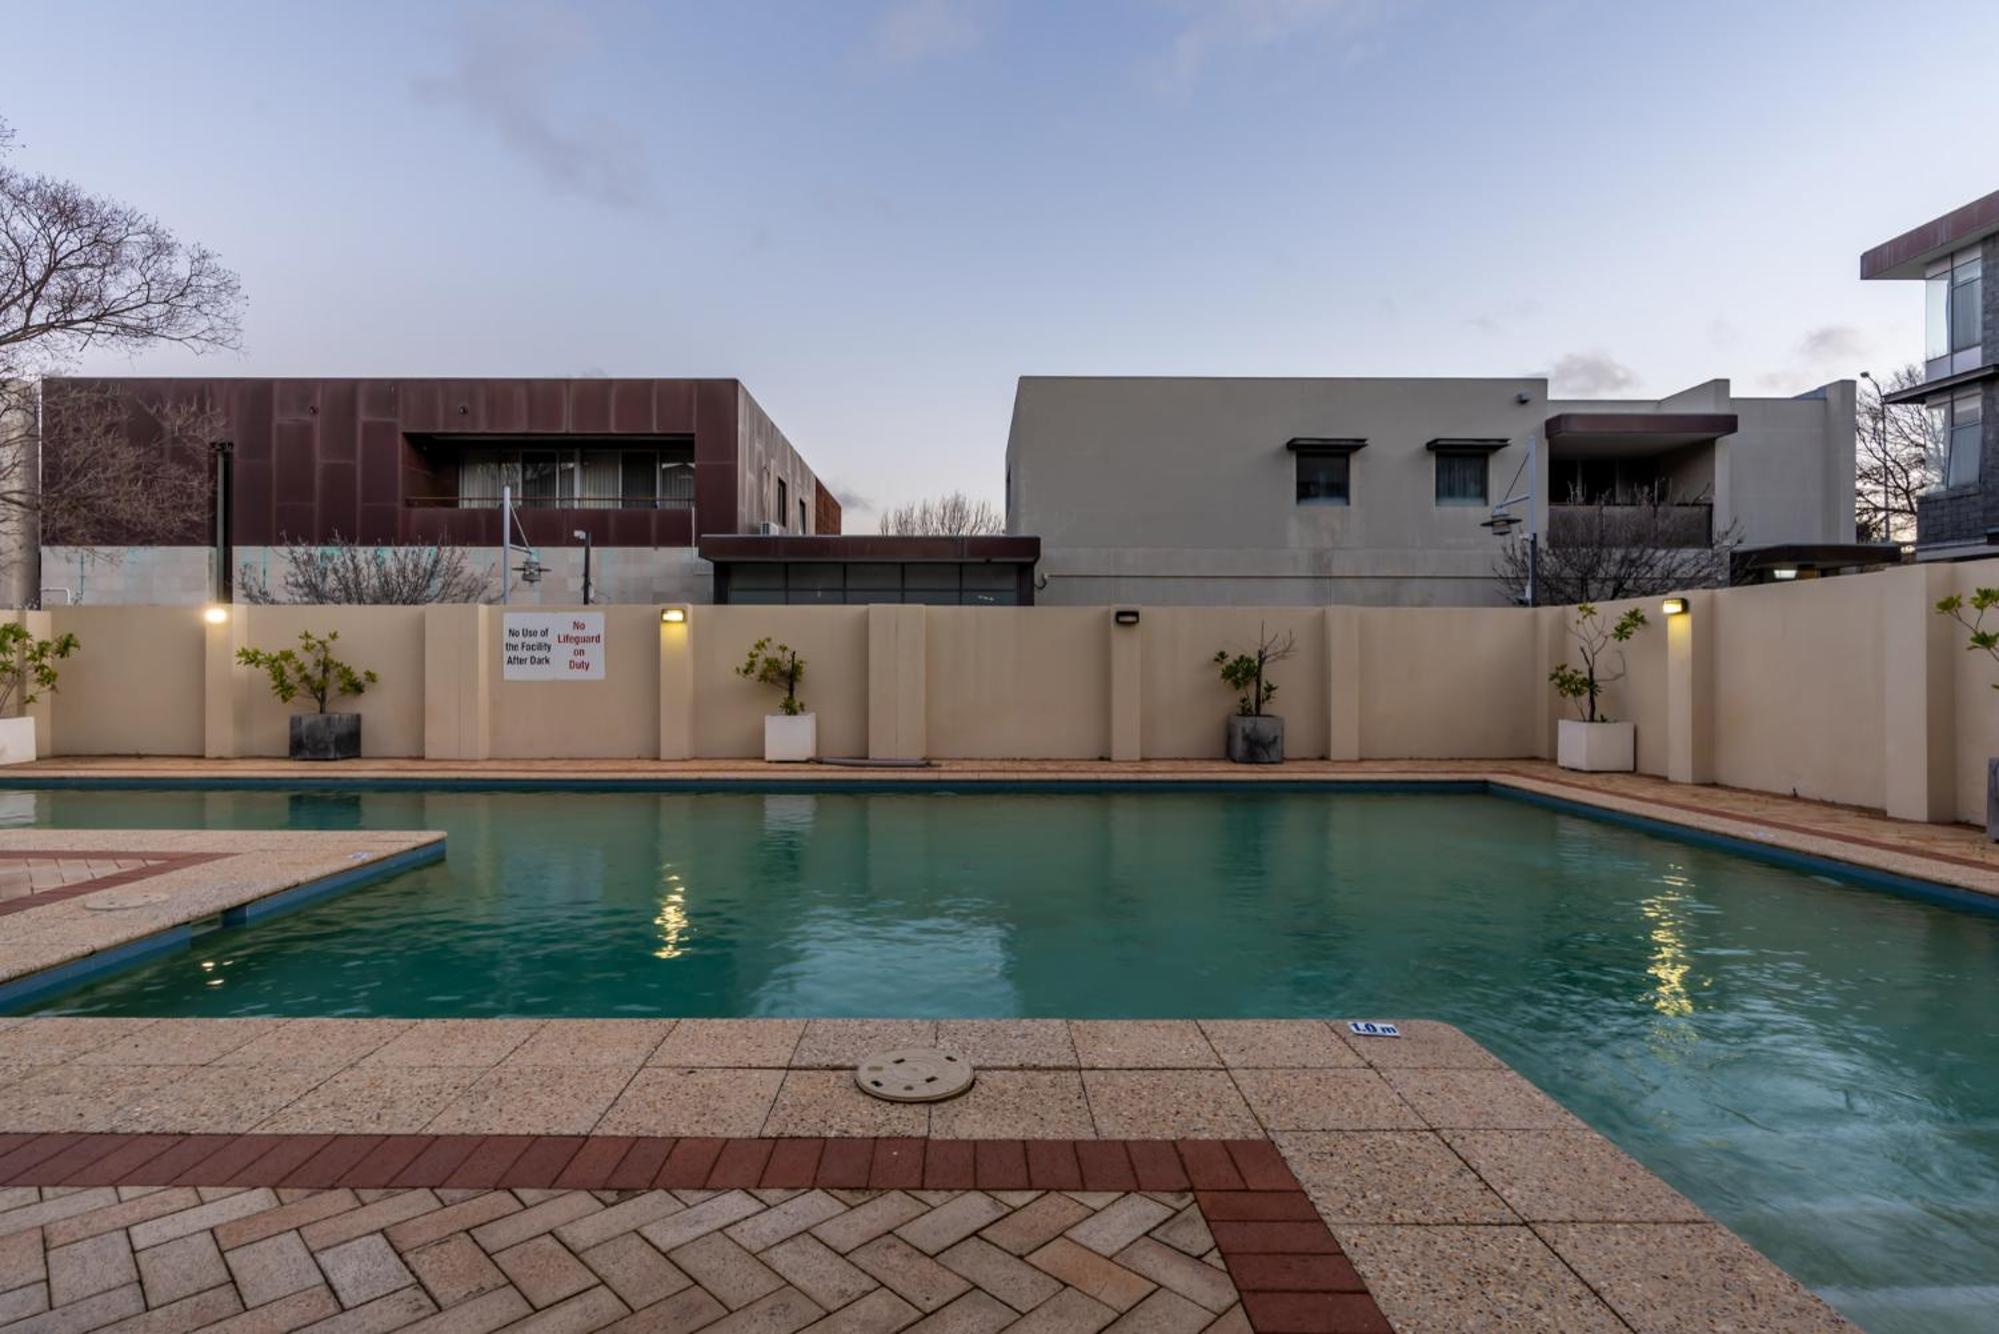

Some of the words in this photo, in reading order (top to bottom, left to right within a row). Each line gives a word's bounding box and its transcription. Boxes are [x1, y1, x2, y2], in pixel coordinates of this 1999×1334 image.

[573, 621, 586, 630] No
[508, 628, 520, 637] No
[522, 628, 538, 637] Use
[540, 628, 549, 637] of
[557, 634, 601, 645] Lifeguard
[505, 642, 519, 651] the
[521, 642, 552, 653] Facility
[573, 648, 585, 656] on
[506, 656, 528, 665] After
[529, 655, 550, 665] Dark
[568, 660, 590, 671] Duty
[1351, 1022, 1378, 1033] 1.0
